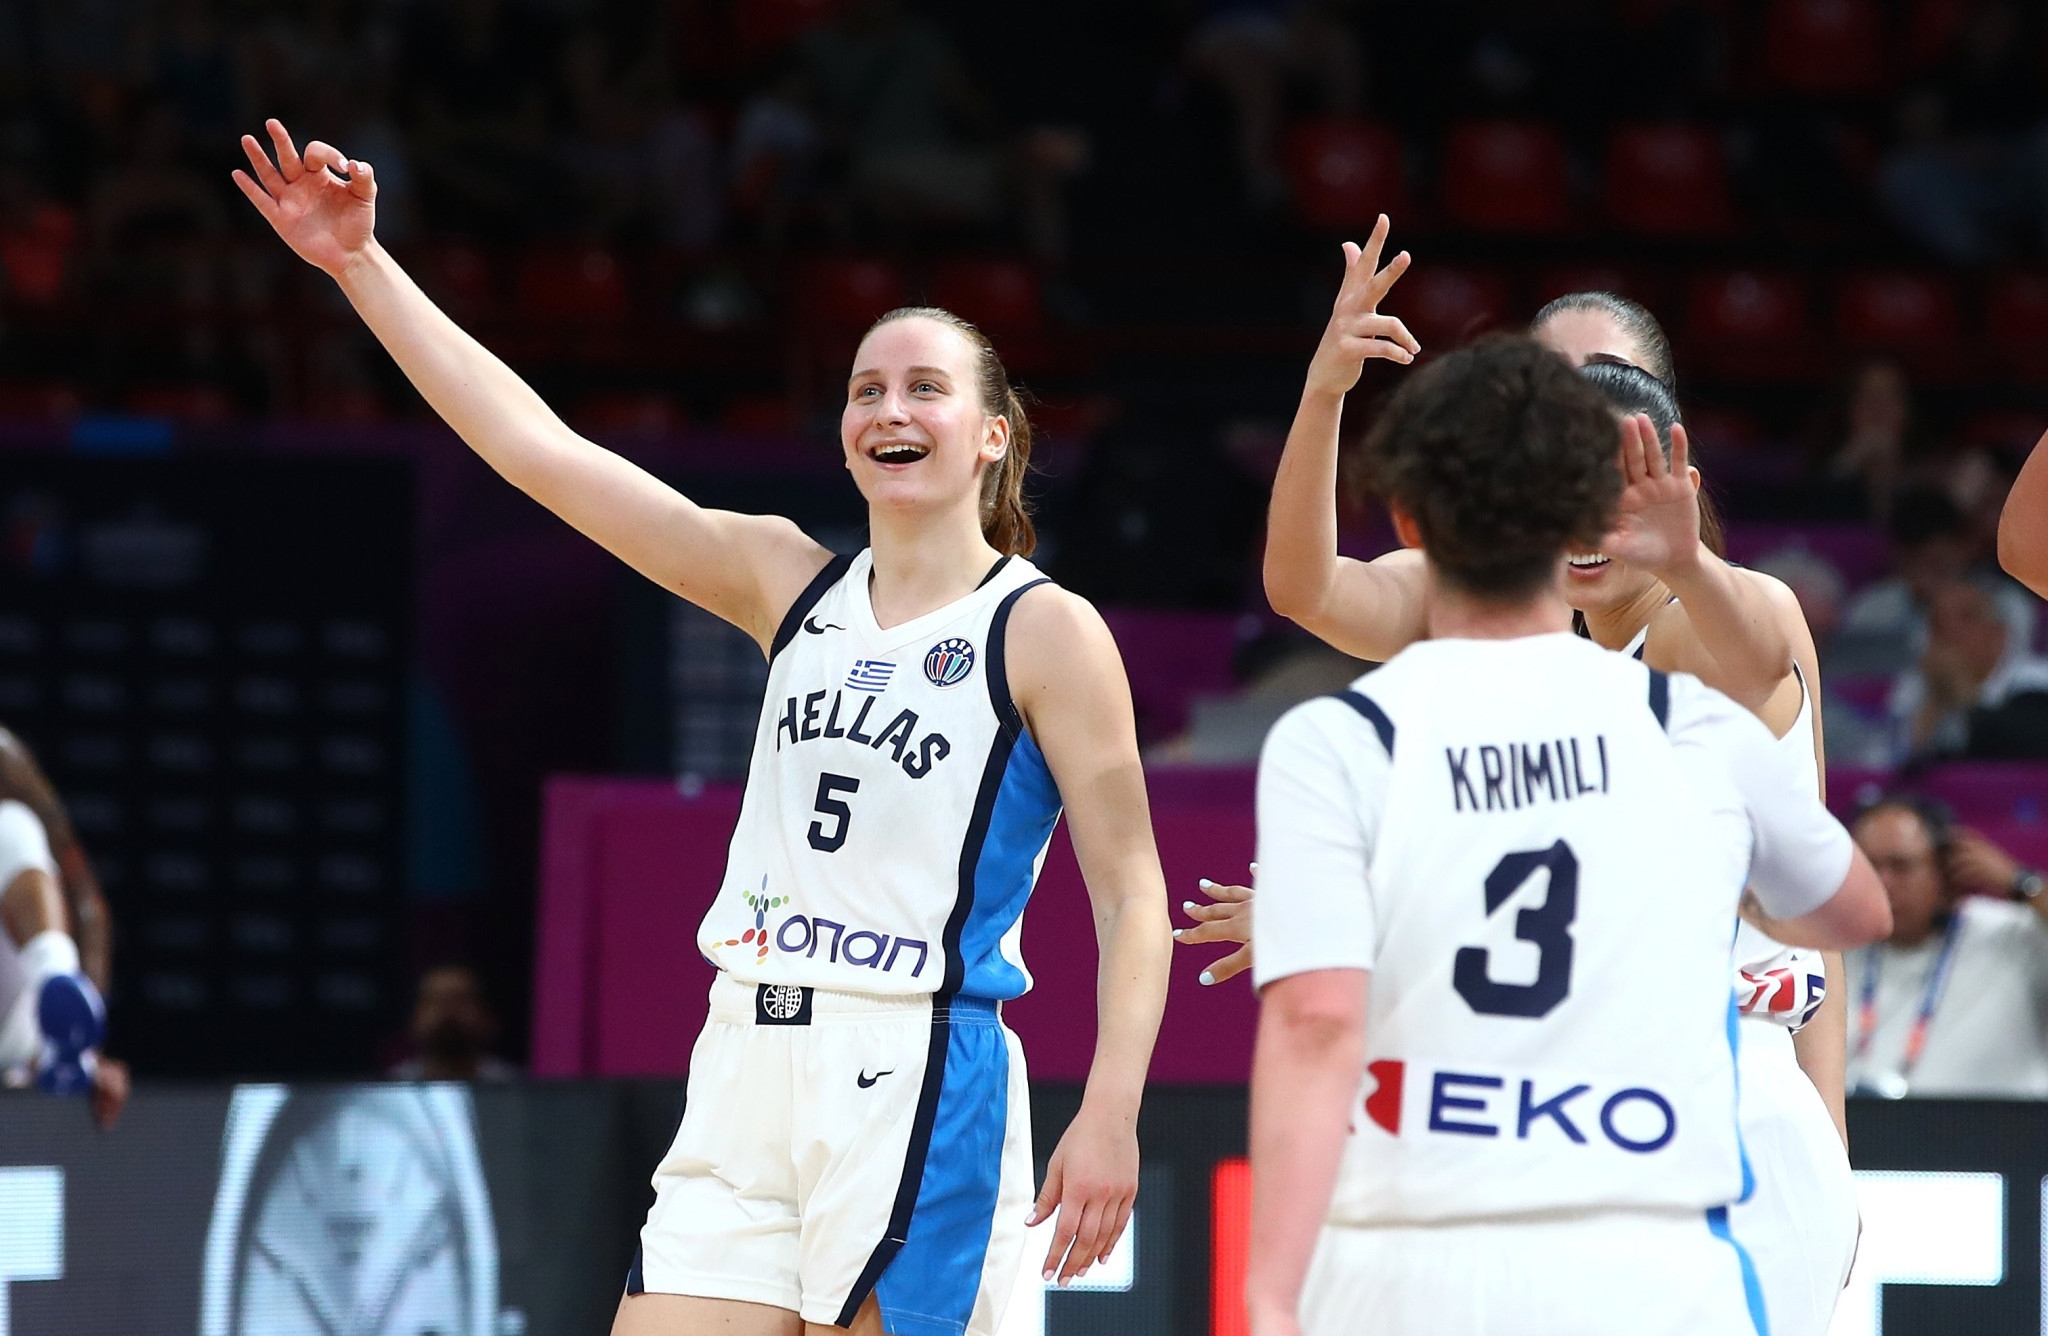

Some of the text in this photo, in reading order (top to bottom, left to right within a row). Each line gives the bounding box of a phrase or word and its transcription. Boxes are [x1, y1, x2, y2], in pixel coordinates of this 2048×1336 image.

[777, 689, 951, 779] HELLAS
[1445, 734, 1608, 812] KRIMILI
[806, 772, 861, 853] 5
[1452, 838, 1580, 1020] 3
[1428, 1070, 1676, 1154] EKO
